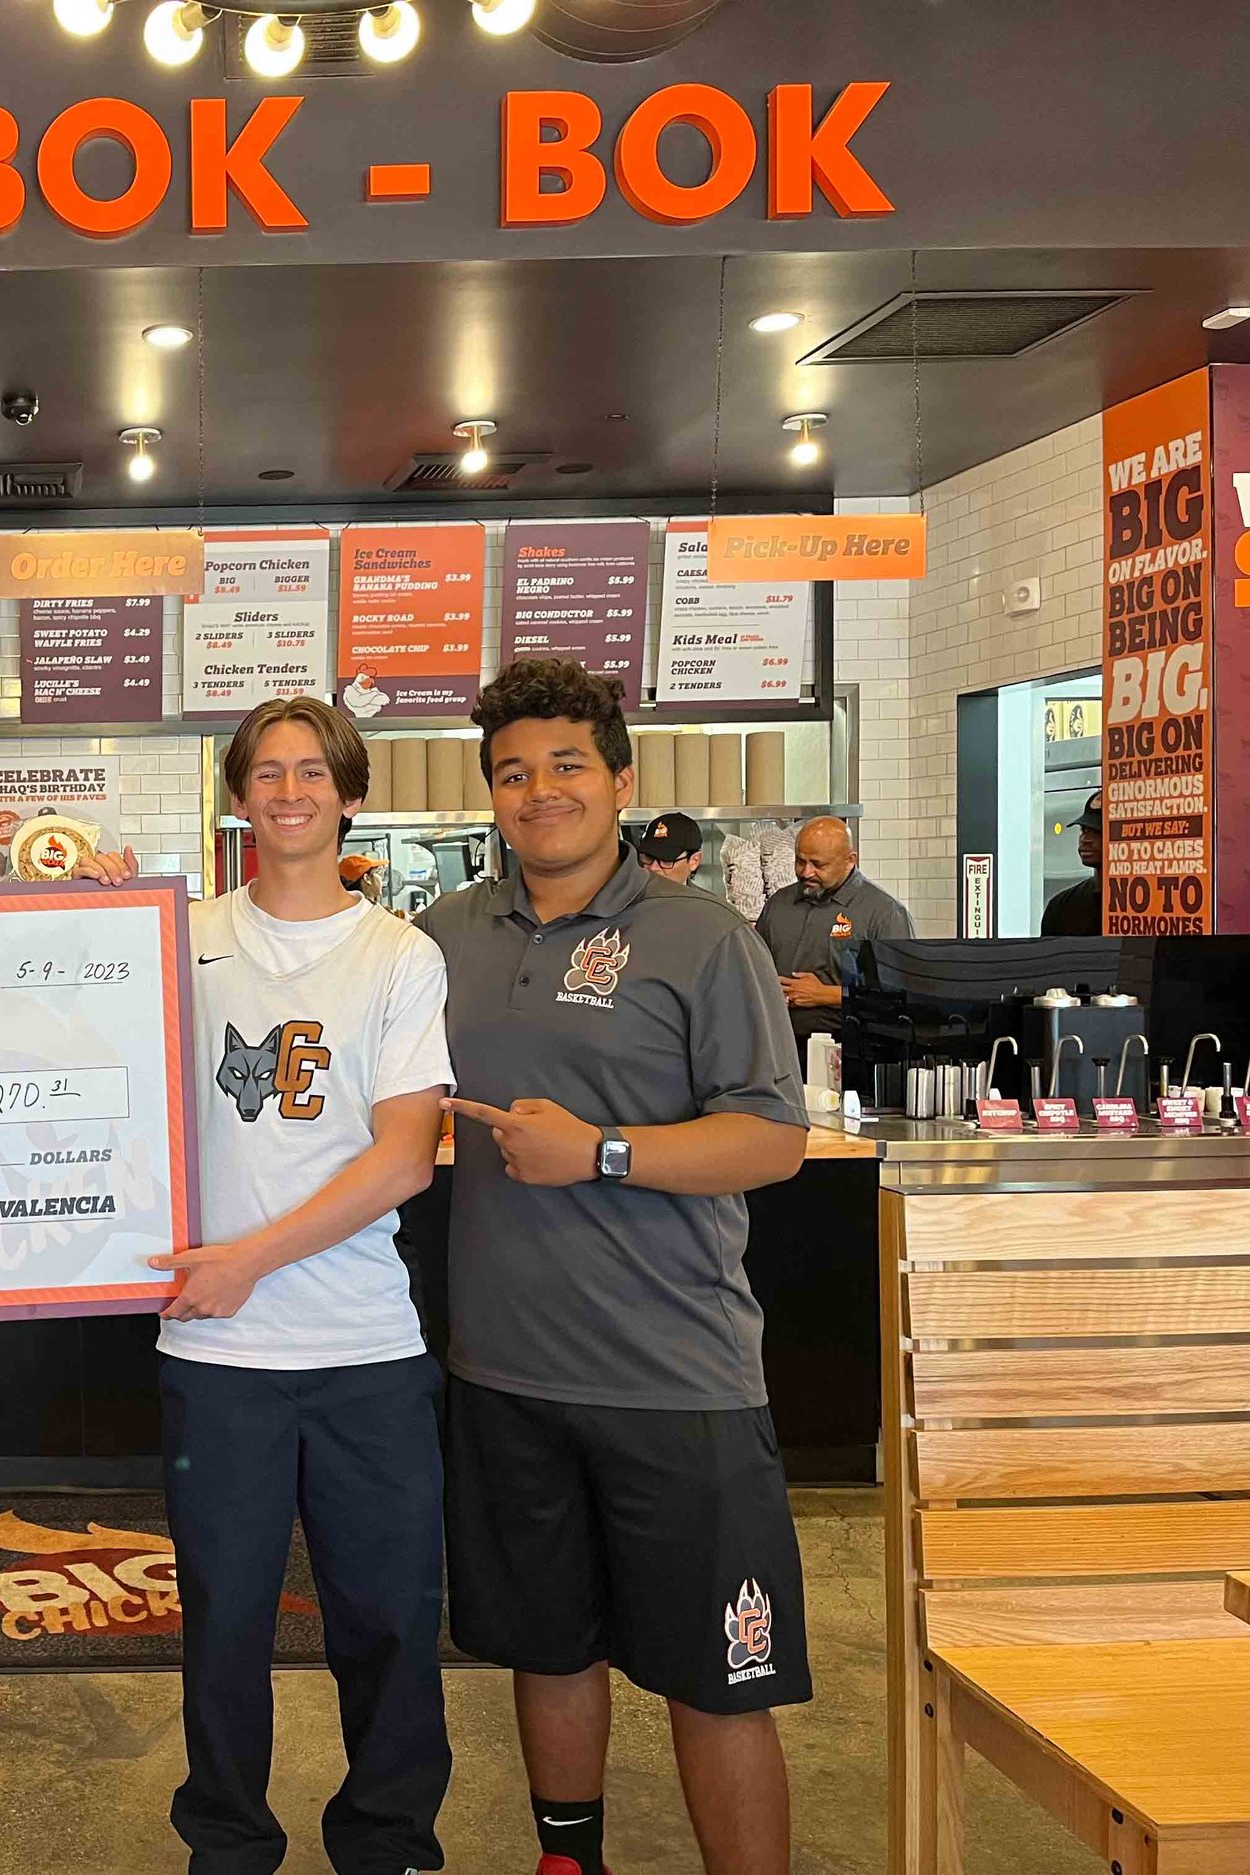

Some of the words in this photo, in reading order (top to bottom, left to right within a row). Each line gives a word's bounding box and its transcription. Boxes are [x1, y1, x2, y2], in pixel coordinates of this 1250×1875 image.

[501, 81, 896, 229] BOK
[1109, 453, 1146, 492] WE
[1151, 431, 1202, 478] ARE
[1110, 465, 1203, 560] BIG
[354, 549, 373, 559] Ice
[376, 548, 417, 558] Cream
[517, 547, 566, 558] Shakes
[724, 536, 838, 561] Pick-Up
[843, 535, 910, 556] Here
[11, 552, 105, 580] Order
[110, 551, 186, 578] Here
[205, 560, 256, 572] Popcorn
[259, 559, 309, 570] Chicken
[354, 559, 431, 569] Sandwiches
[1108, 558, 1131, 584] ON
[1133, 539, 1207, 578] FLAVOR.
[1109, 576, 1154, 618] BIG
[1161, 563, 1202, 605] ON
[34, 600, 62, 608] DIRTY
[65, 599, 93, 607] FRIES
[125, 598, 150, 607] $7.99
[234, 612, 279, 622] Sliders
[535, 610, 593, 618] CONDUCTOR
[606, 609, 633, 617] $5.99
[34, 630, 65, 638] SWEET
[67, 629, 108, 637] POTATO
[124, 628, 150, 637] $4.29
[1109, 601, 1202, 657] BEING
[34, 639, 70, 648] WAFFLE
[70, 638, 102, 647] FRIES
[673, 634, 703, 645] Kids
[705, 634, 738, 644] Meal
[204, 664, 254, 675] Chicken
[256, 663, 307, 674] Tenders
[1108, 643, 1208, 724] BIG.
[1108, 721, 1154, 760] BIG
[1161, 714, 1204, 752] ON
[1108, 752, 1203, 781] DELIVERING
[40, 784, 105, 793] BIRTHDAY
[1108, 775, 1203, 802] GINORMOUS
[1108, 797, 1208, 818] SATISFACTION.
[1122, 824, 1142, 837] BUT
[1146, 822, 1161, 836] WE
[1163, 821, 1190, 835] SAY:
[41, 850, 64, 860] BIG
[1109, 843, 1127, 860] NO
[1131, 842, 1151, 860] TO
[1154, 840, 1204, 858] CAGES
[969, 865, 987, 874] FIRE
[1109, 862, 1130, 874] AND
[1133, 861, 1162, 874] HEAT
[1164, 860, 1206, 874] LAMPS.
[1109, 876, 1150, 913] NO
[1157, 876, 1203, 914] TO
[1108, 916, 1203, 935] HORMONES
[556, 991, 614, 1009] BASKETBALL
[30, 1149, 112, 1165] DOLLARS
[1, 1591, 182, 1641] CHICK
[728, 1663, 776, 1684] BASKETBALL
